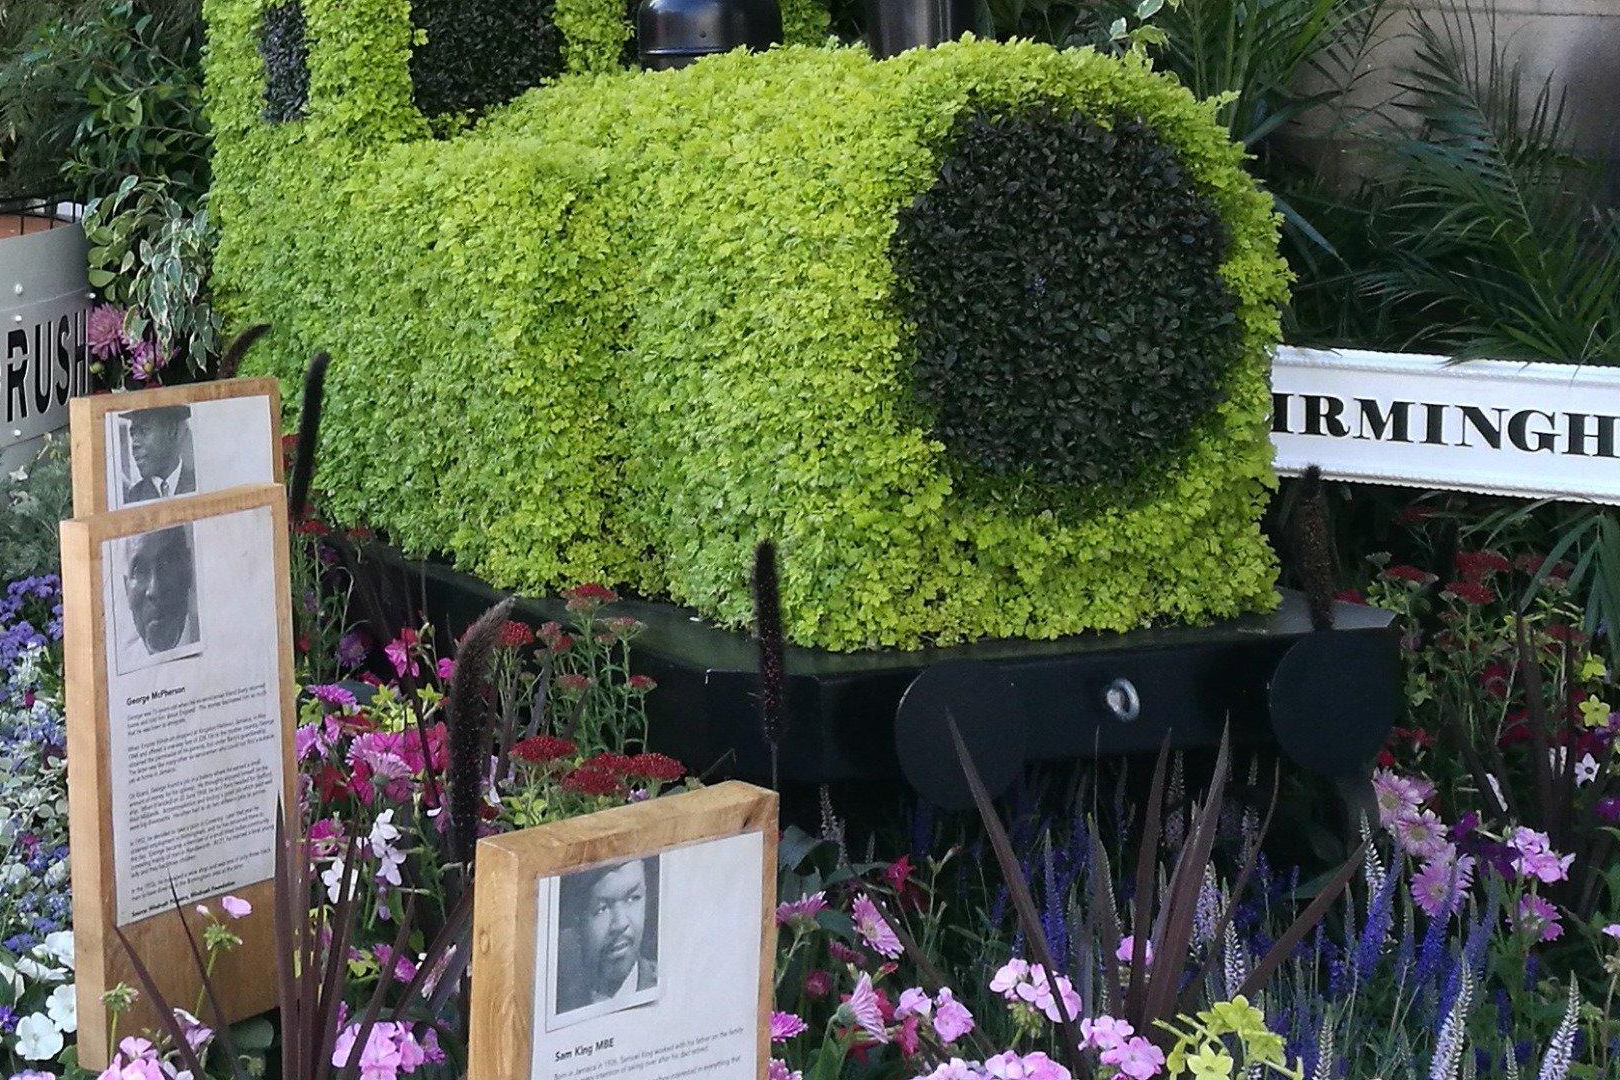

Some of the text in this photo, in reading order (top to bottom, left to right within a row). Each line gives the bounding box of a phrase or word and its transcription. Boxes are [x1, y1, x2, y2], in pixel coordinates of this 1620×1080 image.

[126, 695, 150, 706] George
[555, 1037, 614, 1061] Sam King MBE
